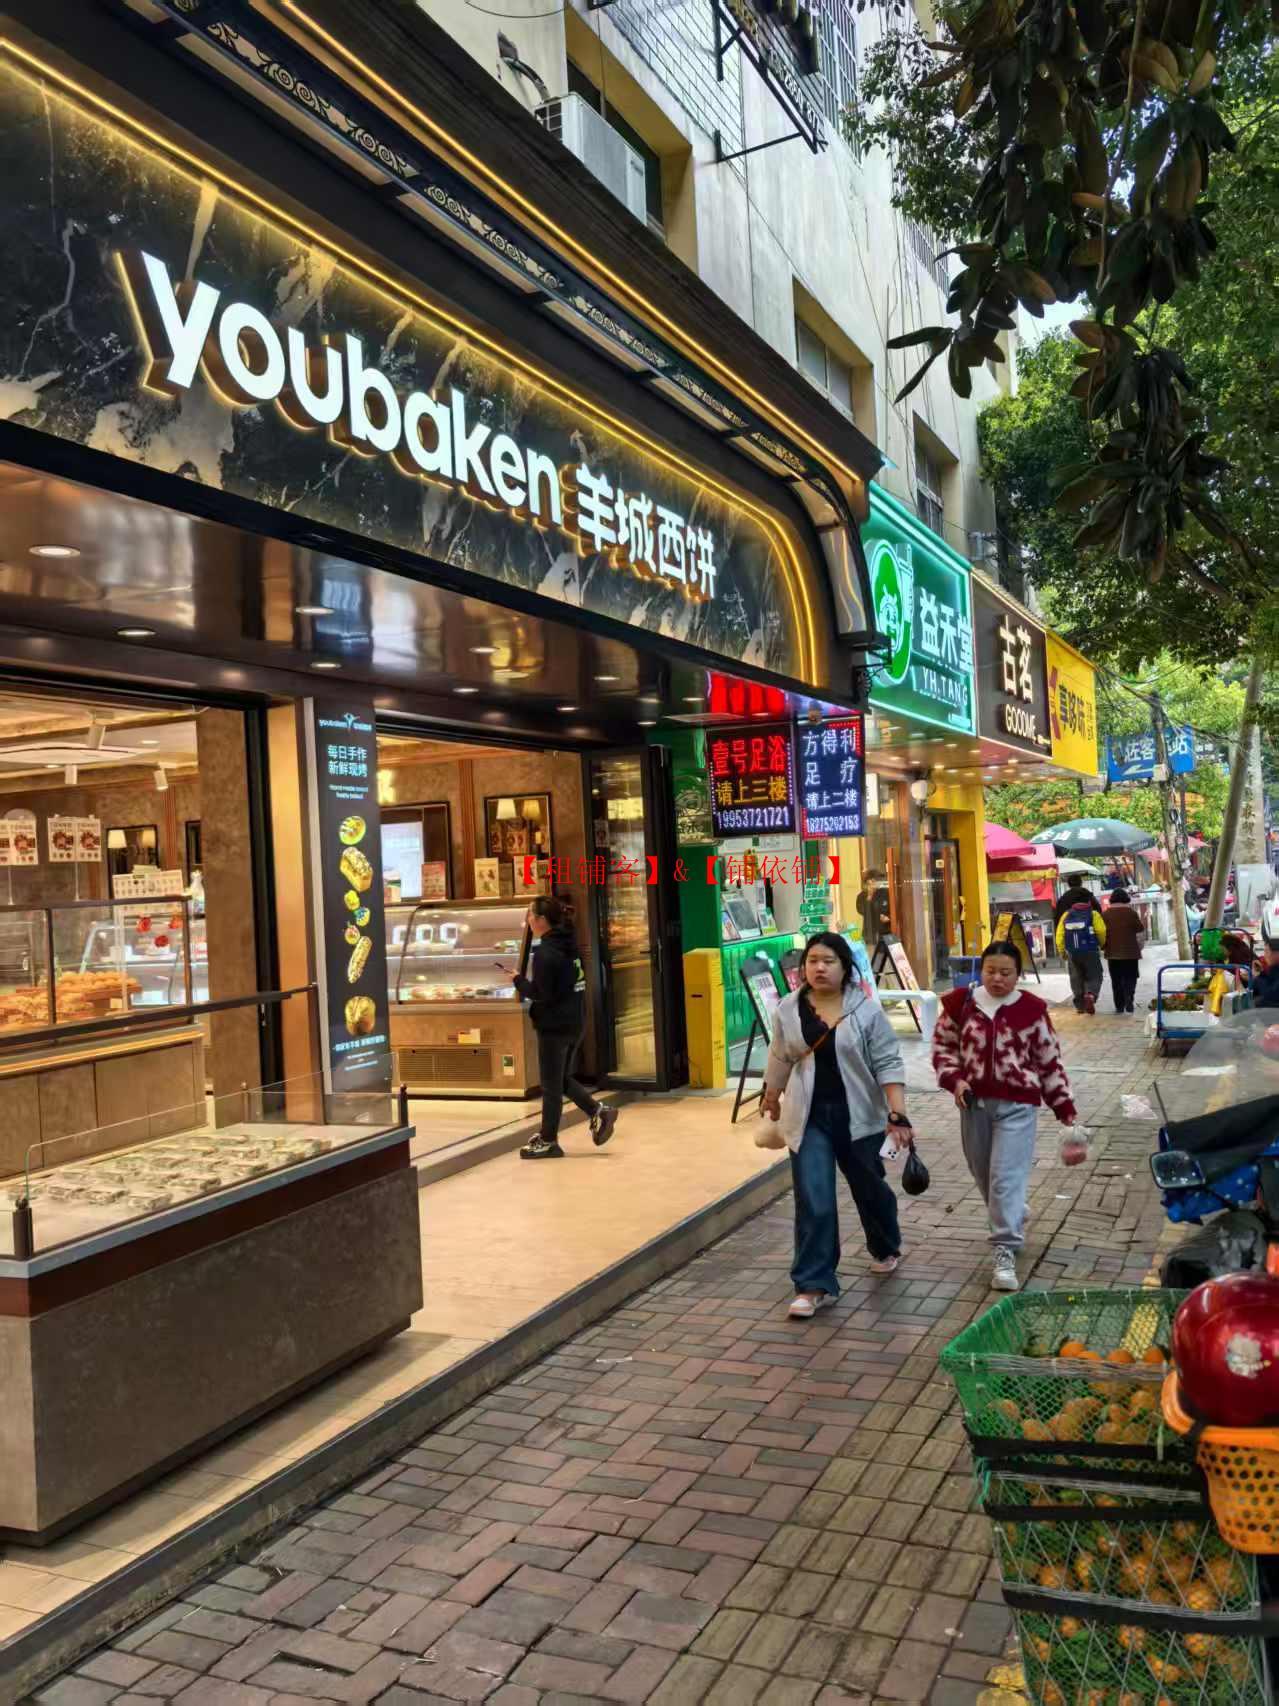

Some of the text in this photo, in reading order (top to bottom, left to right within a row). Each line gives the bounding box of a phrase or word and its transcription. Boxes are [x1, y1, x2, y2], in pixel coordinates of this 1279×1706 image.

[141, 250, 717, 599] youbaken 羊城西饼
[919, 587, 973, 673] 益禾堂
[999, 614, 1033, 704] 古茗
[327, 744, 368, 761] 每日手作
[712, 735, 786, 776] 壹号足浴
[802, 727, 856, 756] 方得利
[715, 776, 787, 806] 请上三楼
[805, 787, 858, 811] 请上二楼
